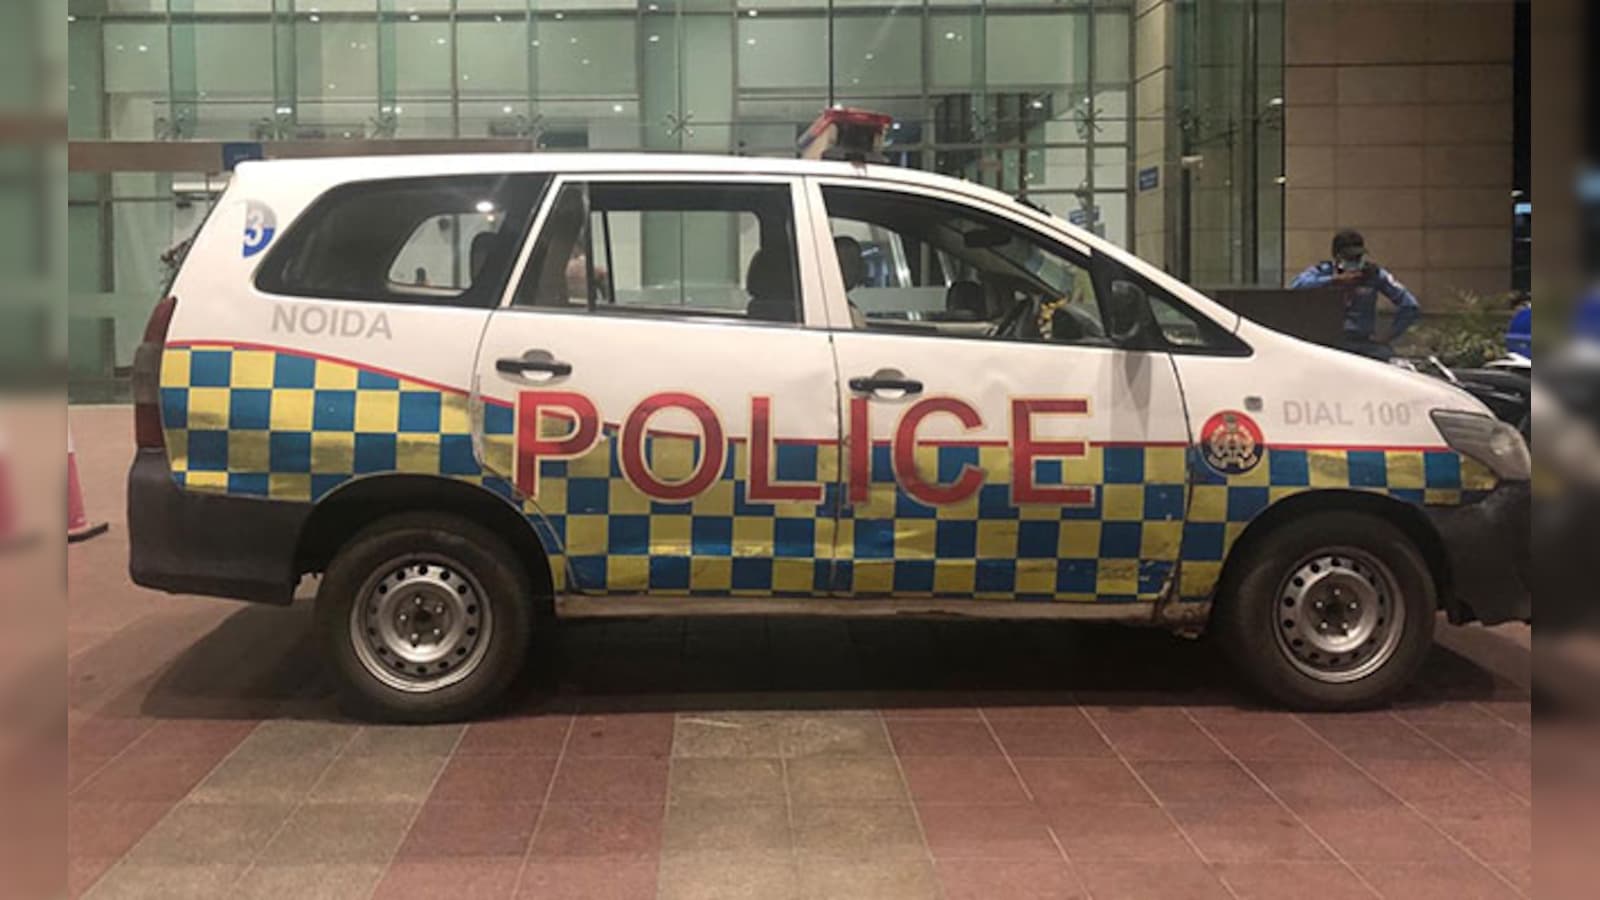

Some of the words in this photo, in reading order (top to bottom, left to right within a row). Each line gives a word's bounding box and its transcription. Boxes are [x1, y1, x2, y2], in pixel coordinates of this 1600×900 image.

[246, 209, 264, 247] 3
[272, 304, 393, 341] NOIDA
[1282, 400, 1353, 426] DIAL
[1361, 400, 1411, 427] 100
[513, 389, 1096, 506] POLICE
